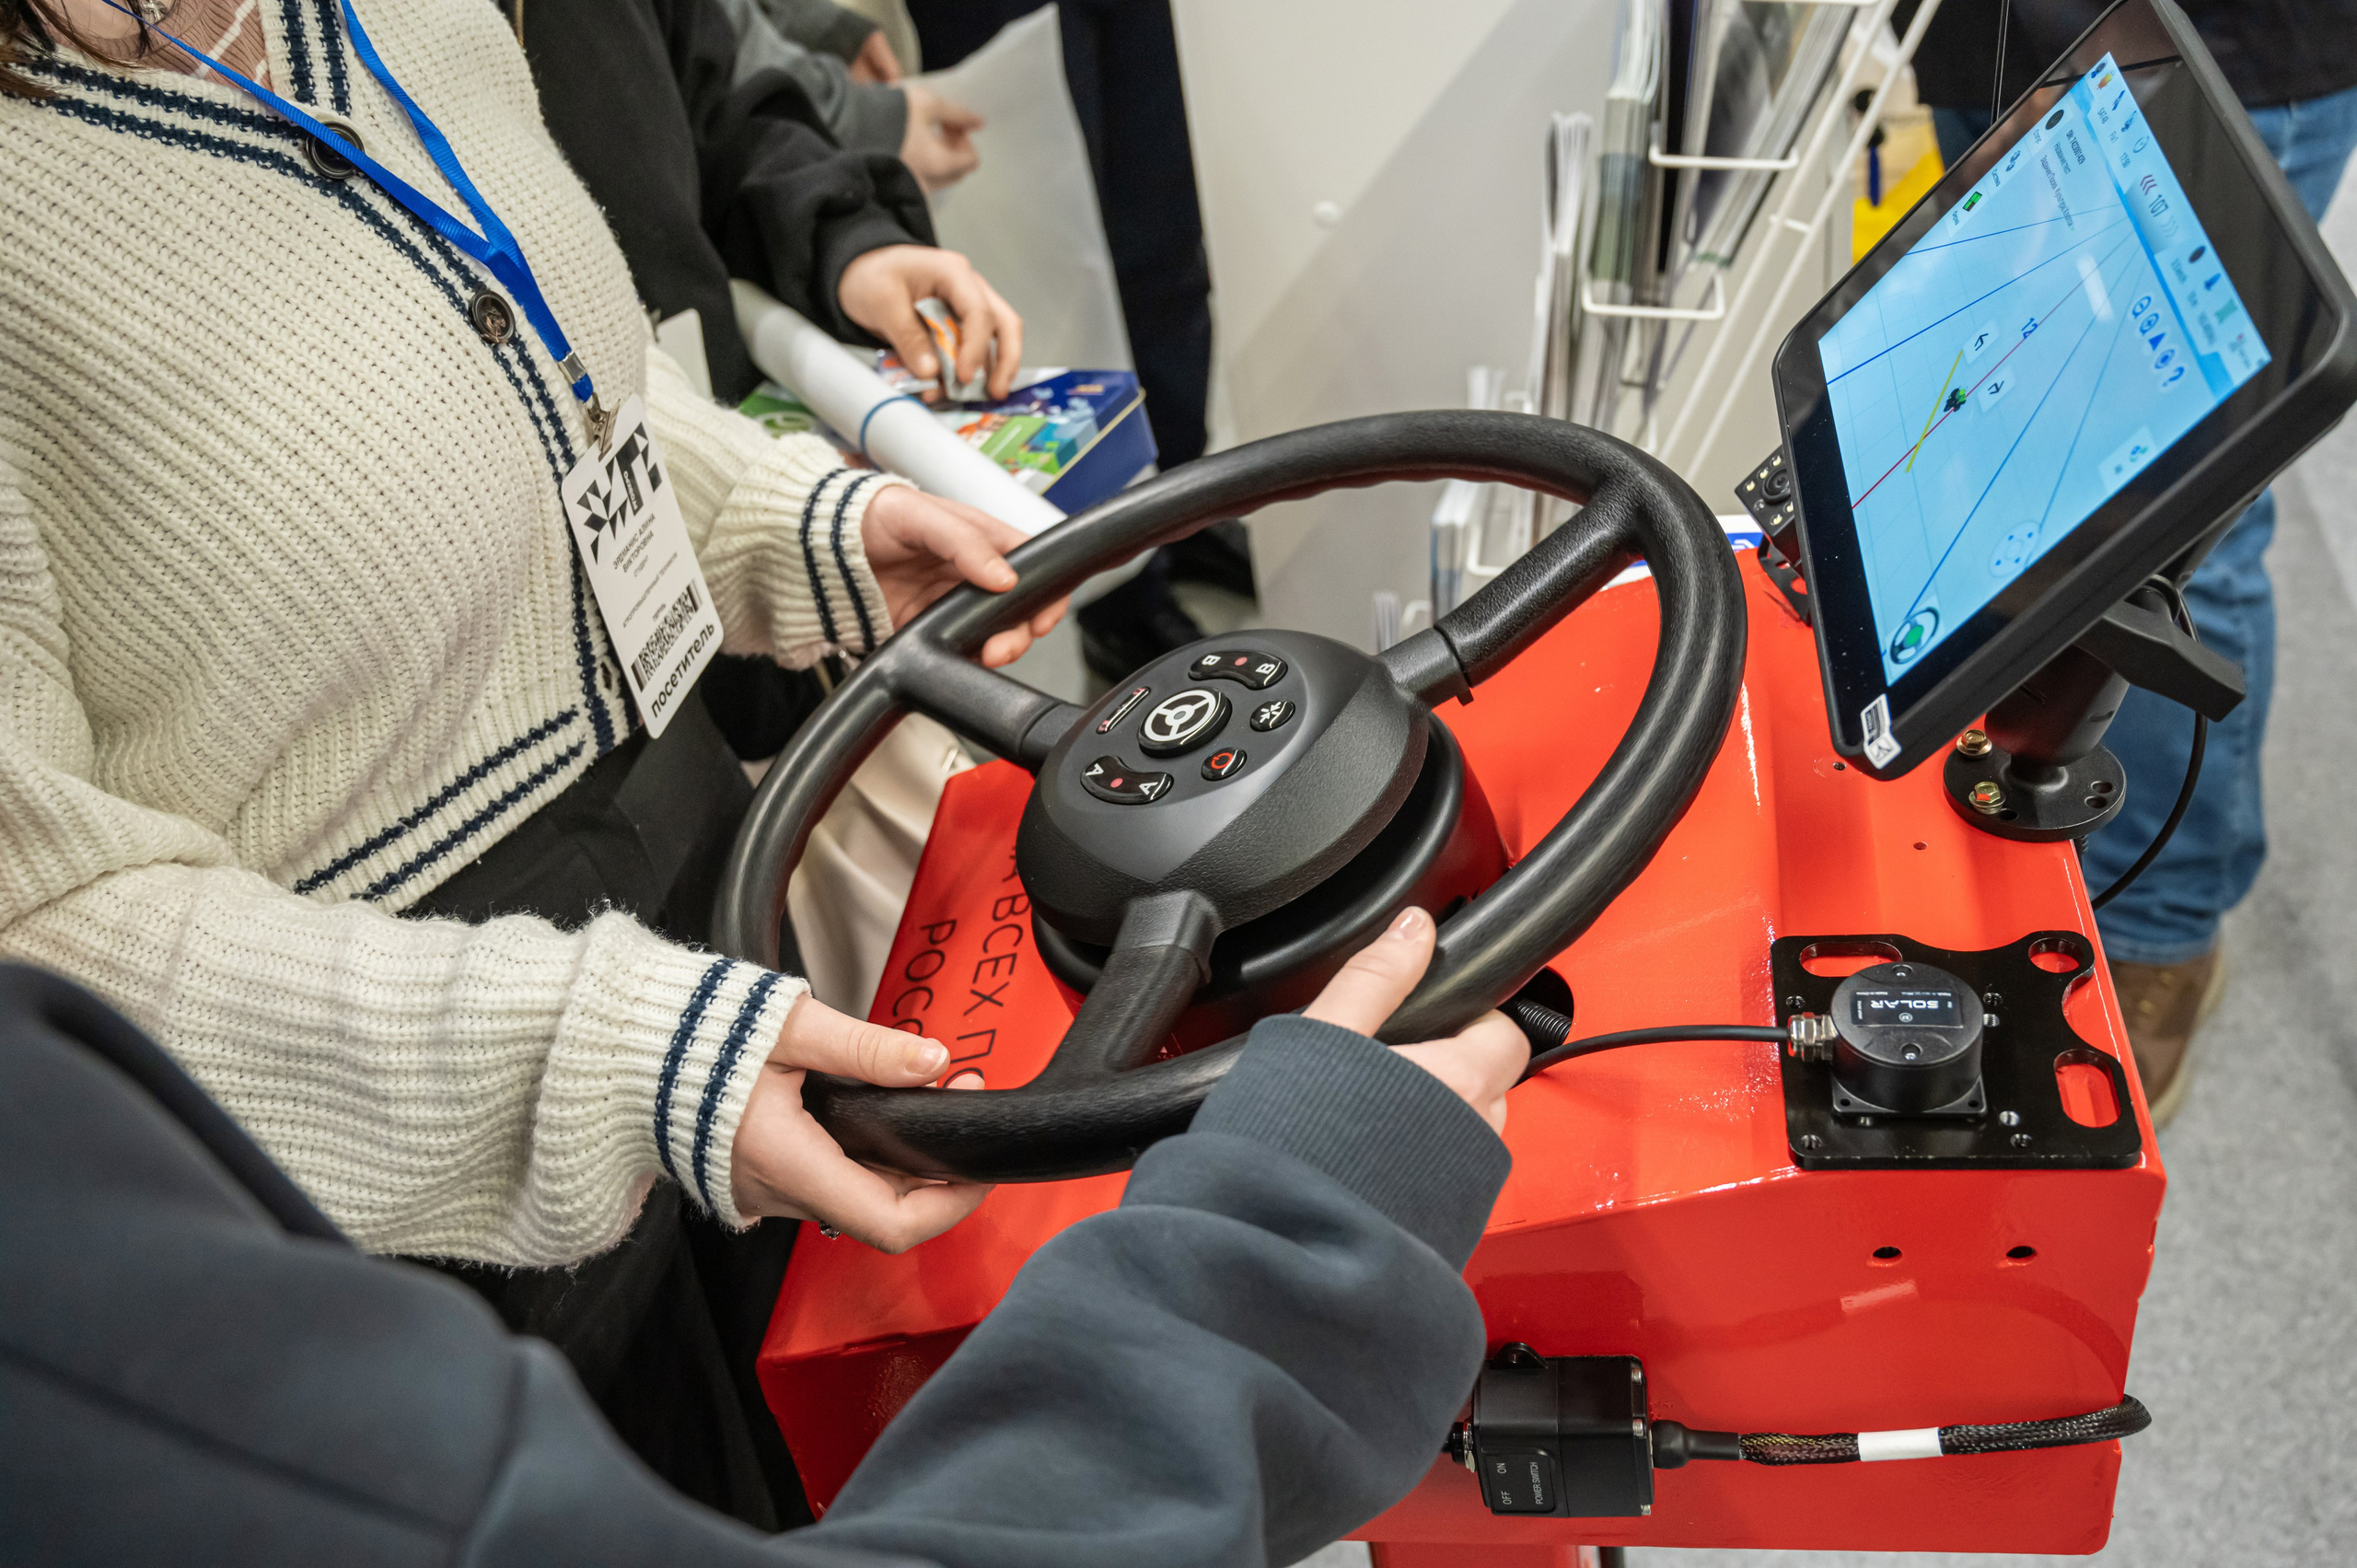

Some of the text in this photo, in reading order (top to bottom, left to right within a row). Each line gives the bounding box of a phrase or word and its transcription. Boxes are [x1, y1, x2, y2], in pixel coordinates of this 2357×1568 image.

[2148, 194, 2169, 218] 107
[2021, 318, 2038, 341] 12
[613, 513, 656, 570] ЭРДМАНИС АЛИНА
[622, 530, 654, 573] ВИКТОРОВНА
[651, 624, 714, 717] посетитель
[1255, 662, 1276, 675] B
[1138, 781, 1158, 795] A
[964, 893, 1031, 1016] ВСЕХ
[1870, 1000, 1939, 1009] SOLAR
[1496, 1462, 1507, 1474] ON
[1530, 1461, 1543, 1504] POWER SWITCH
[1501, 1490, 1513, 1504] OFF
